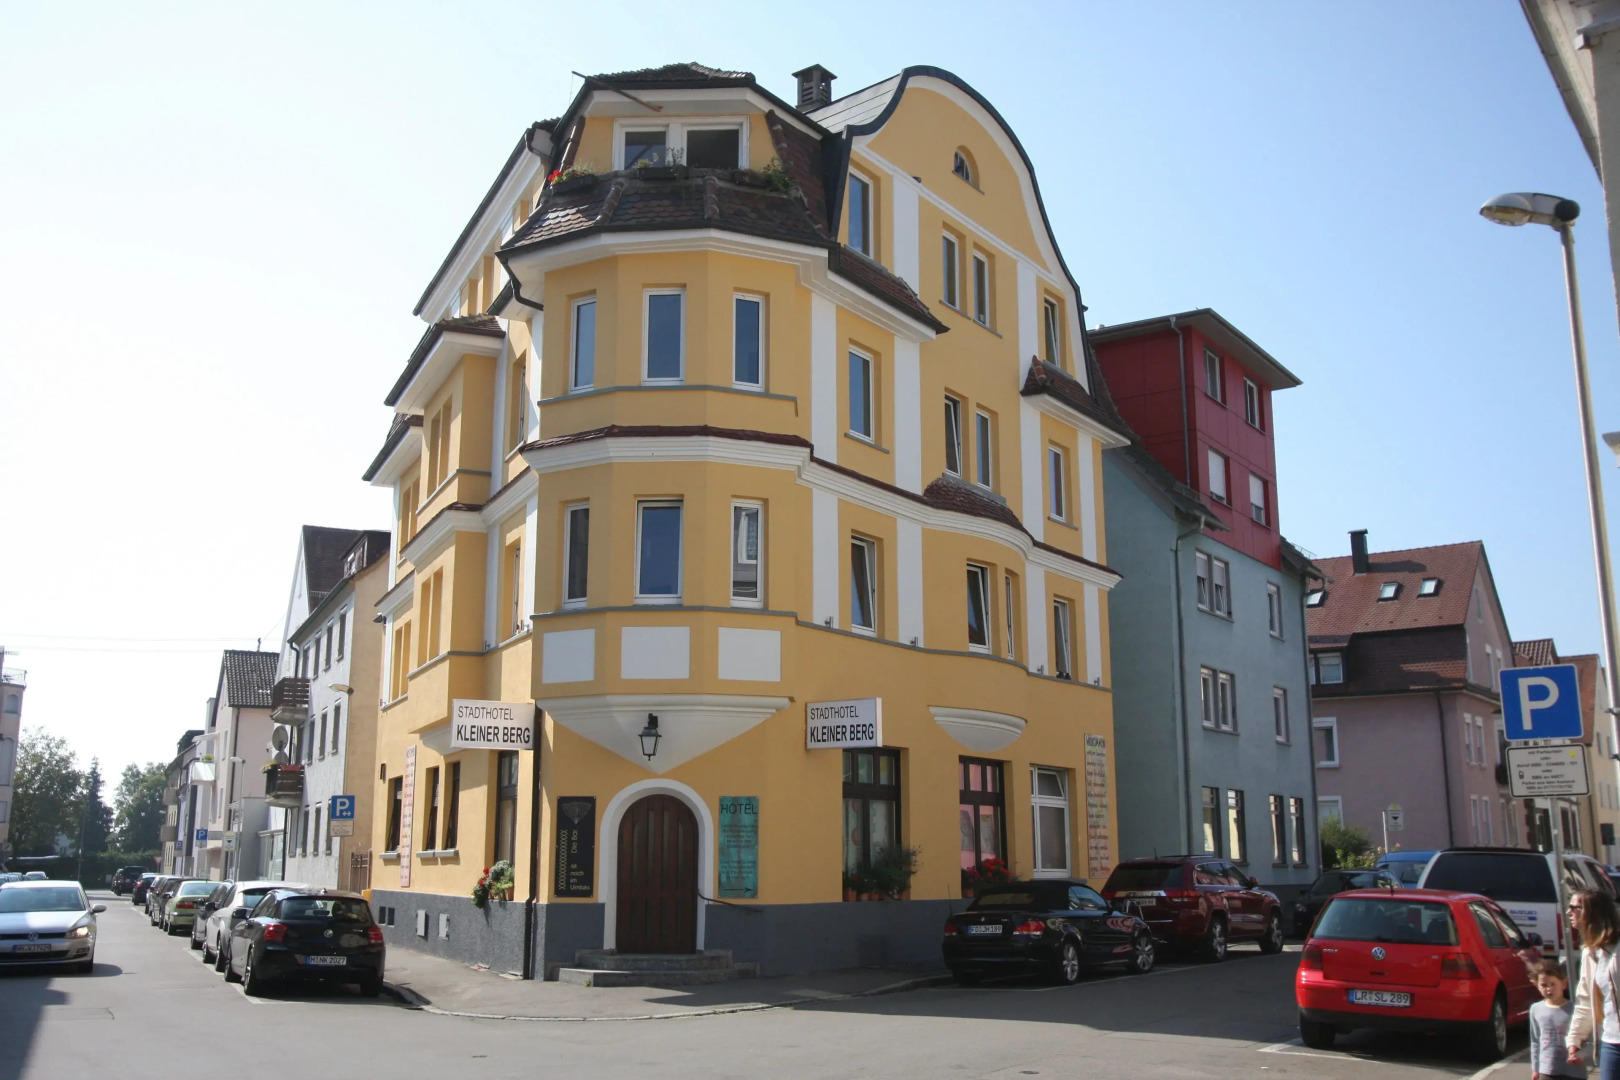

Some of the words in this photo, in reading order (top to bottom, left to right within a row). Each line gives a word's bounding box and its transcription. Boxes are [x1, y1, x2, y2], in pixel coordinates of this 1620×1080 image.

[1517, 676, 1559, 730] P
[458, 705, 514, 721] STADTHOTEL
[810, 705, 859, 720] STADTHOTEL
[456, 724, 500, 743] KLEINER
[502, 726, 531, 744] BERG
[810, 724, 847, 743] KLEINER
[849, 723, 874, 741] BERG
[336, 798, 350, 817] P
[720, 803, 758, 815] HOTEL
[199, 830, 206, 839] P
[570, 829, 578, 841] Bar
[990, 925, 1002, 933] 189
[1355, 990, 1368, 1001] LR
[1374, 991, 1387, 1002] SL
[1390, 993, 1409, 1004] 289
